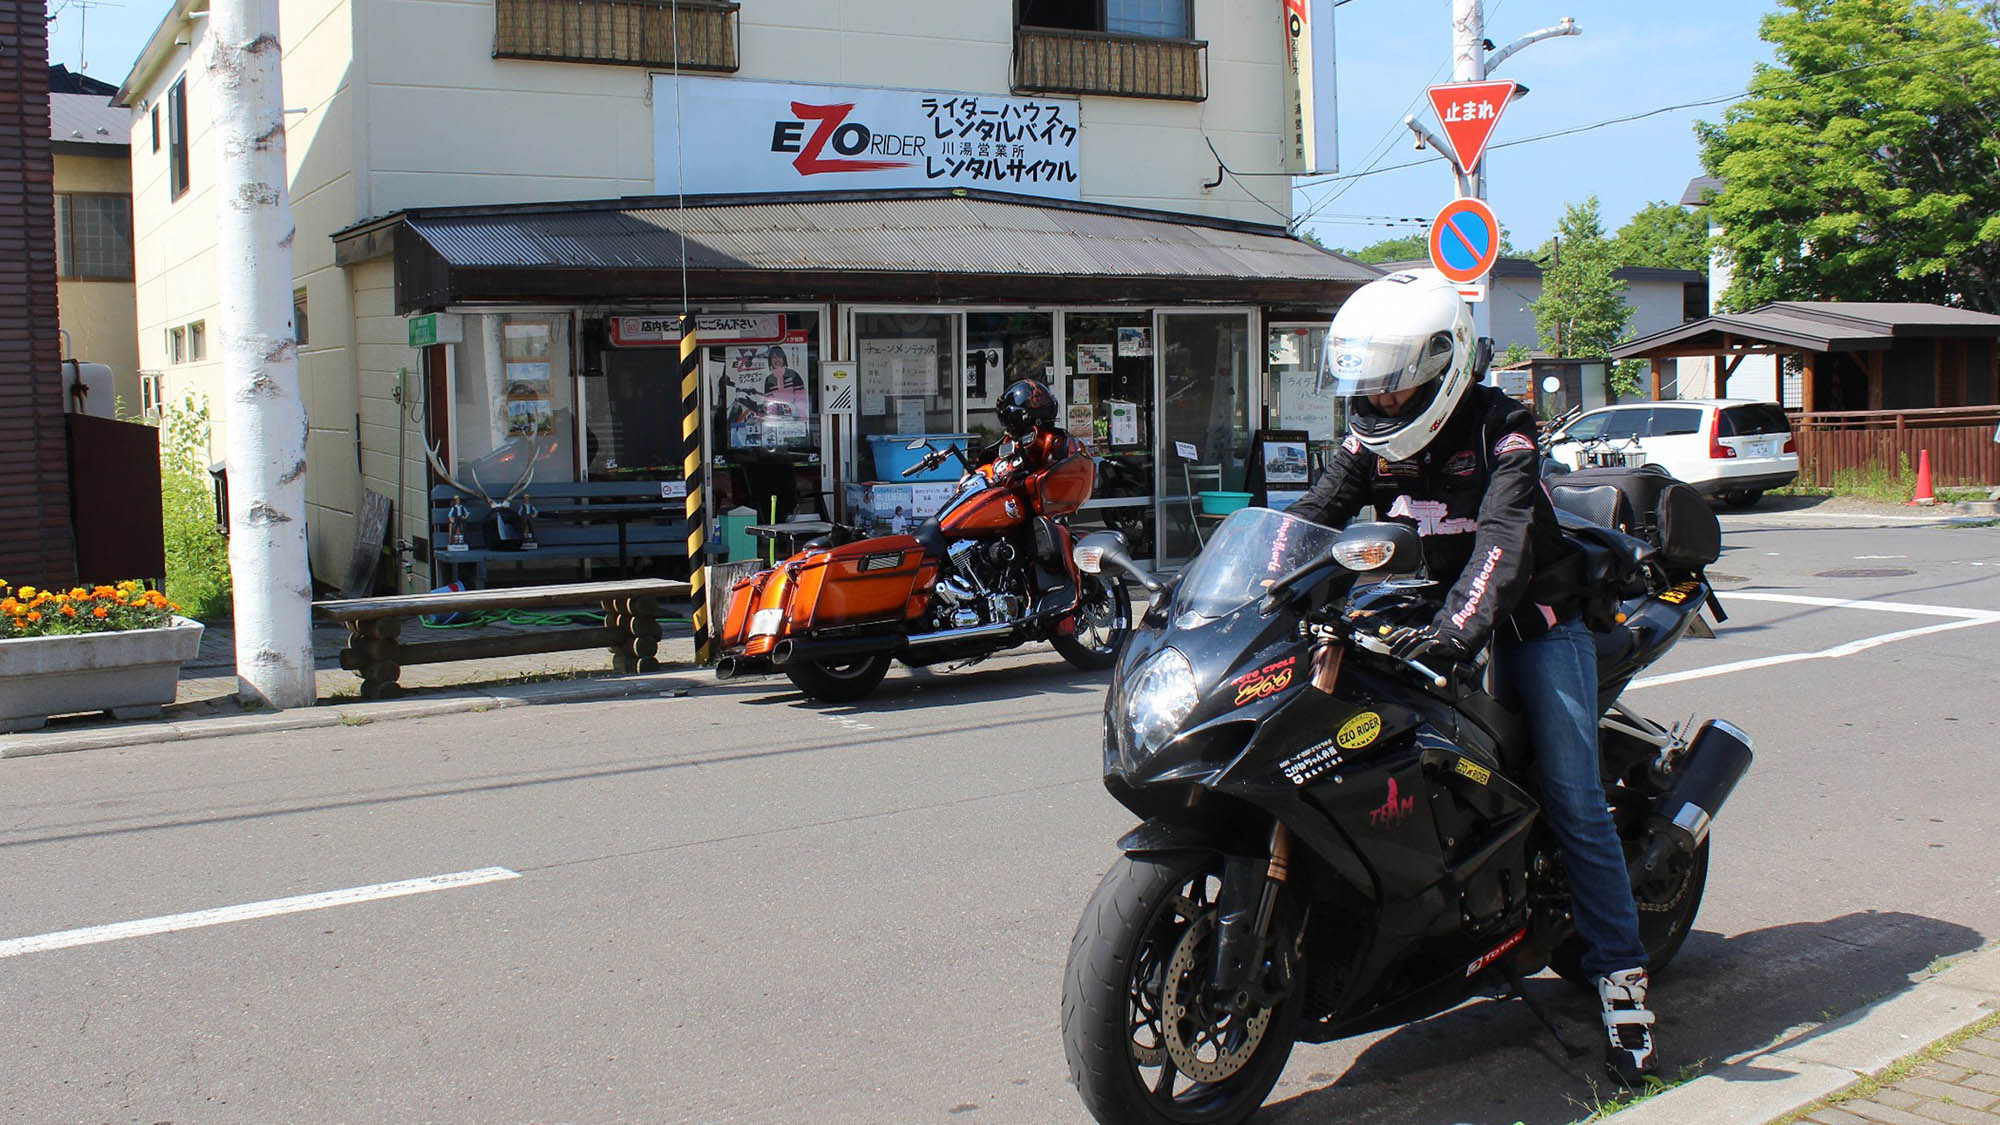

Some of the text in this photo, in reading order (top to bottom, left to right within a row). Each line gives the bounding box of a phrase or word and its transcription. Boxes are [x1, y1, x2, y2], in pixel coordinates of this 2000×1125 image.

[921, 97, 1063, 123] ライダーハウス
[1444, 100, 1495, 122] 止まれ
[934, 117, 1077, 147] レンタルバイク
[870, 133, 926, 156] RIDER
[941, 142, 1025, 159] 川湯営業所
[926, 156, 1077, 183] レンタルサイクル
[641, 317, 757, 332] 店内をごにごらん下さい
[1338, 717, 1380, 745] EZO RIDER
